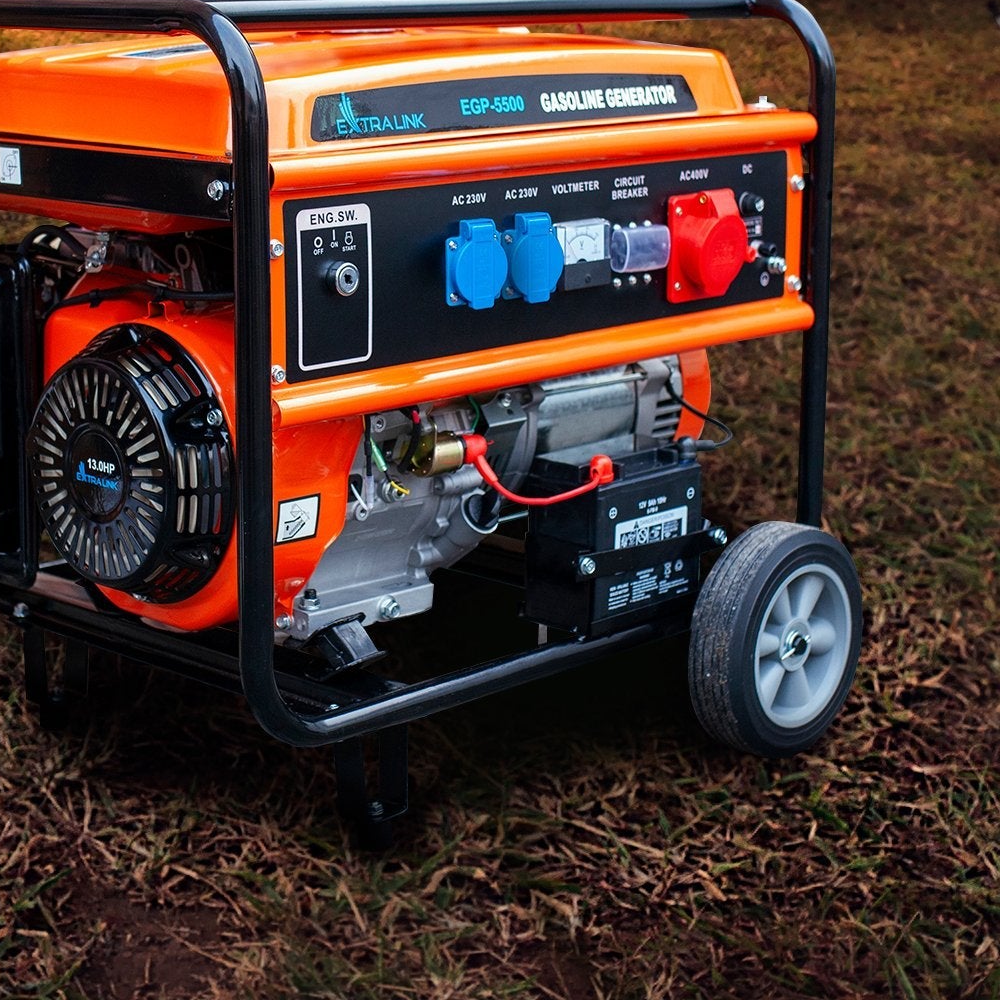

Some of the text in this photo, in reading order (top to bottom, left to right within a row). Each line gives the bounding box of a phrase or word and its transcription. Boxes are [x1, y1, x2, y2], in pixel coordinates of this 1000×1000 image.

[459, 95, 525, 116] EGP-5500
[539, 84, 678, 113] GASOLINE GENERATOR
[336, 97, 428, 135] EXTRALINK
[679, 168, 709, 182] AC400V
[742, 163, 753, 175] DC
[551, 180, 600, 195] VOLTMETER
[614, 175, 646, 188] CIRCUIT
[451, 192, 487, 206] AC 230V
[505, 187, 539, 200] AC 230V
[611, 186, 649, 201] BREAKER
[310, 209, 358, 226] ENG.SW.
[313, 247, 324, 256] OFF
[330, 241, 339, 249] ON
[342, 244, 357, 252] START
[87, 457, 115, 475] 13.0HP
[76, 467, 119, 490] EXTRALINK
